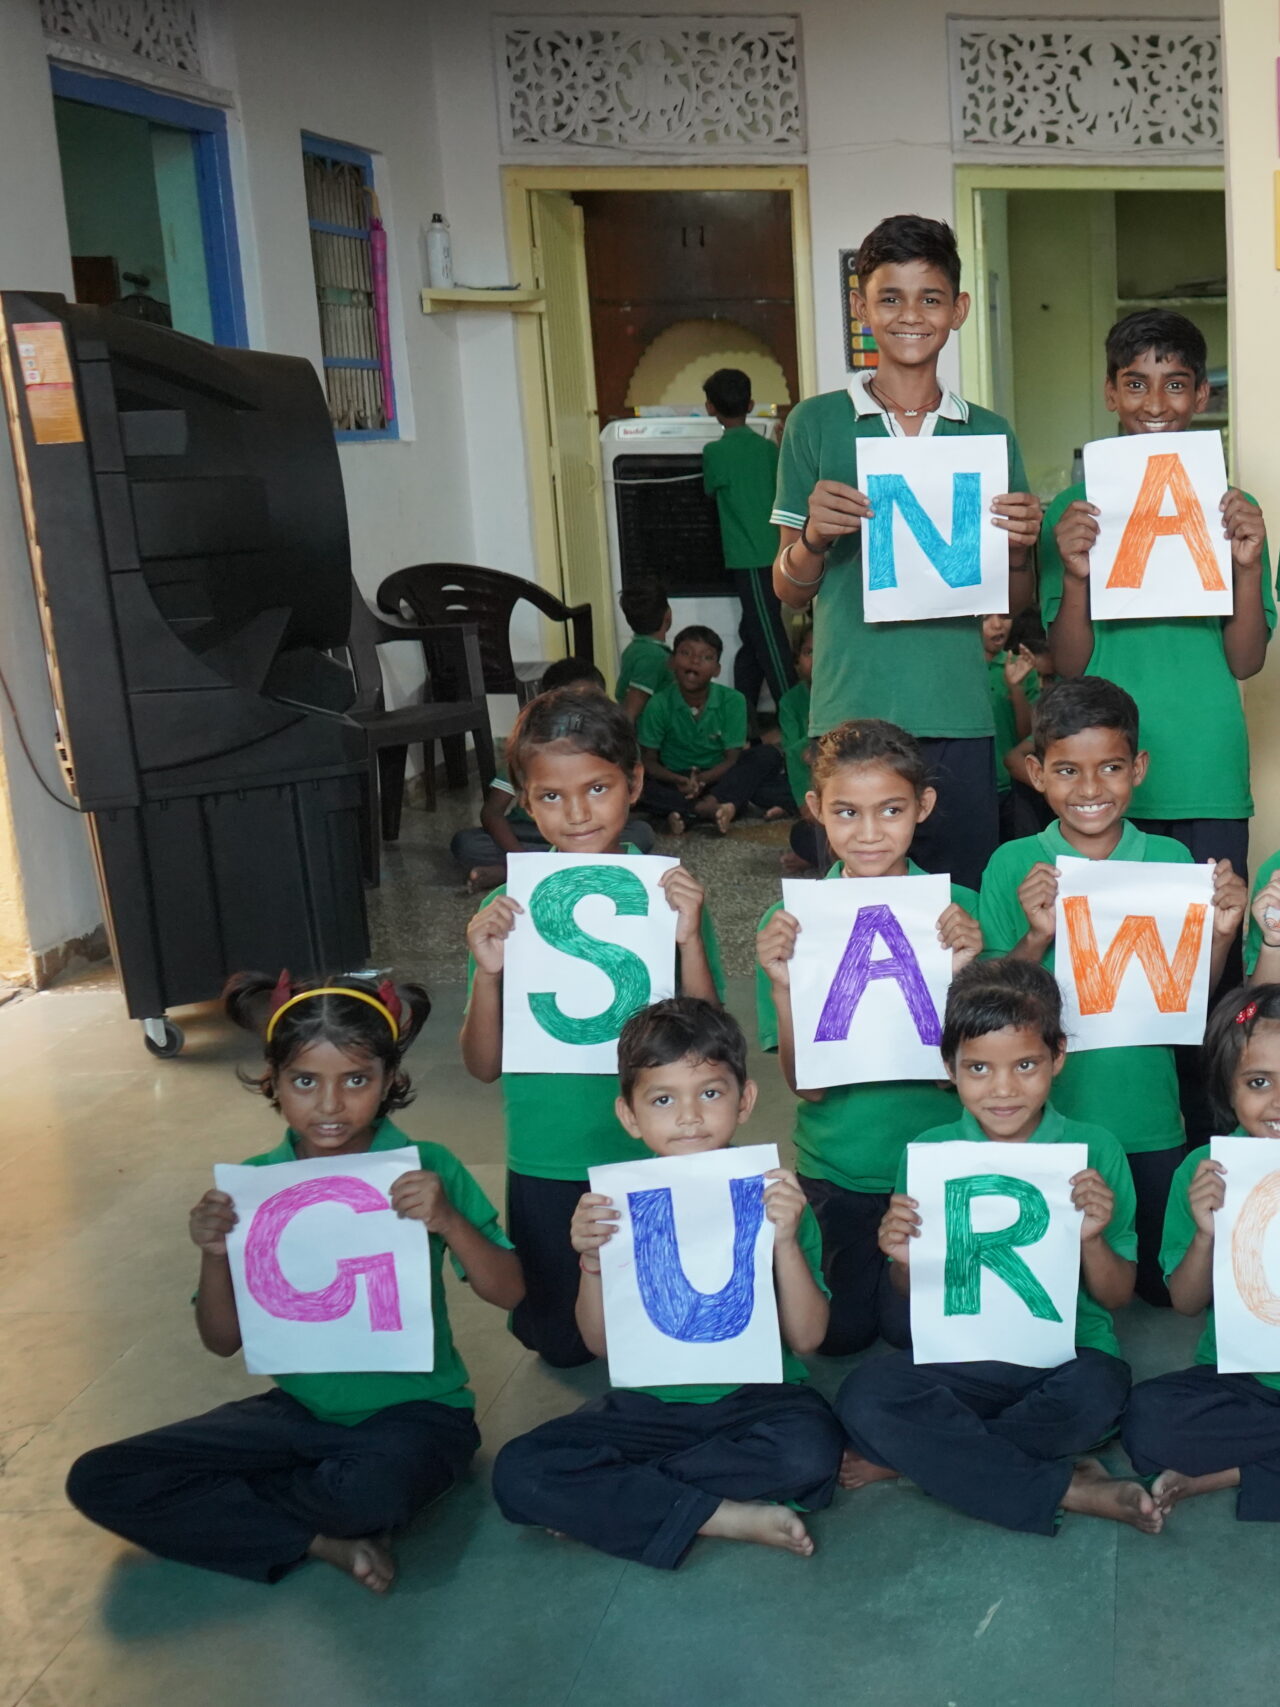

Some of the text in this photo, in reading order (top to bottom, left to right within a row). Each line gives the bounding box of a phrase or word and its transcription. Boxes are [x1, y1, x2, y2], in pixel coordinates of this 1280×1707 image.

[867, 472, 982, 591] N
[1107, 455, 1226, 590] A
[527, 865, 651, 1046] S
[814, 905, 944, 1047] A
[1062, 898, 1207, 1016] W
[245, 1175, 404, 1332] G
[627, 1174, 765, 1343] U
[943, 1173, 1066, 1324] R
